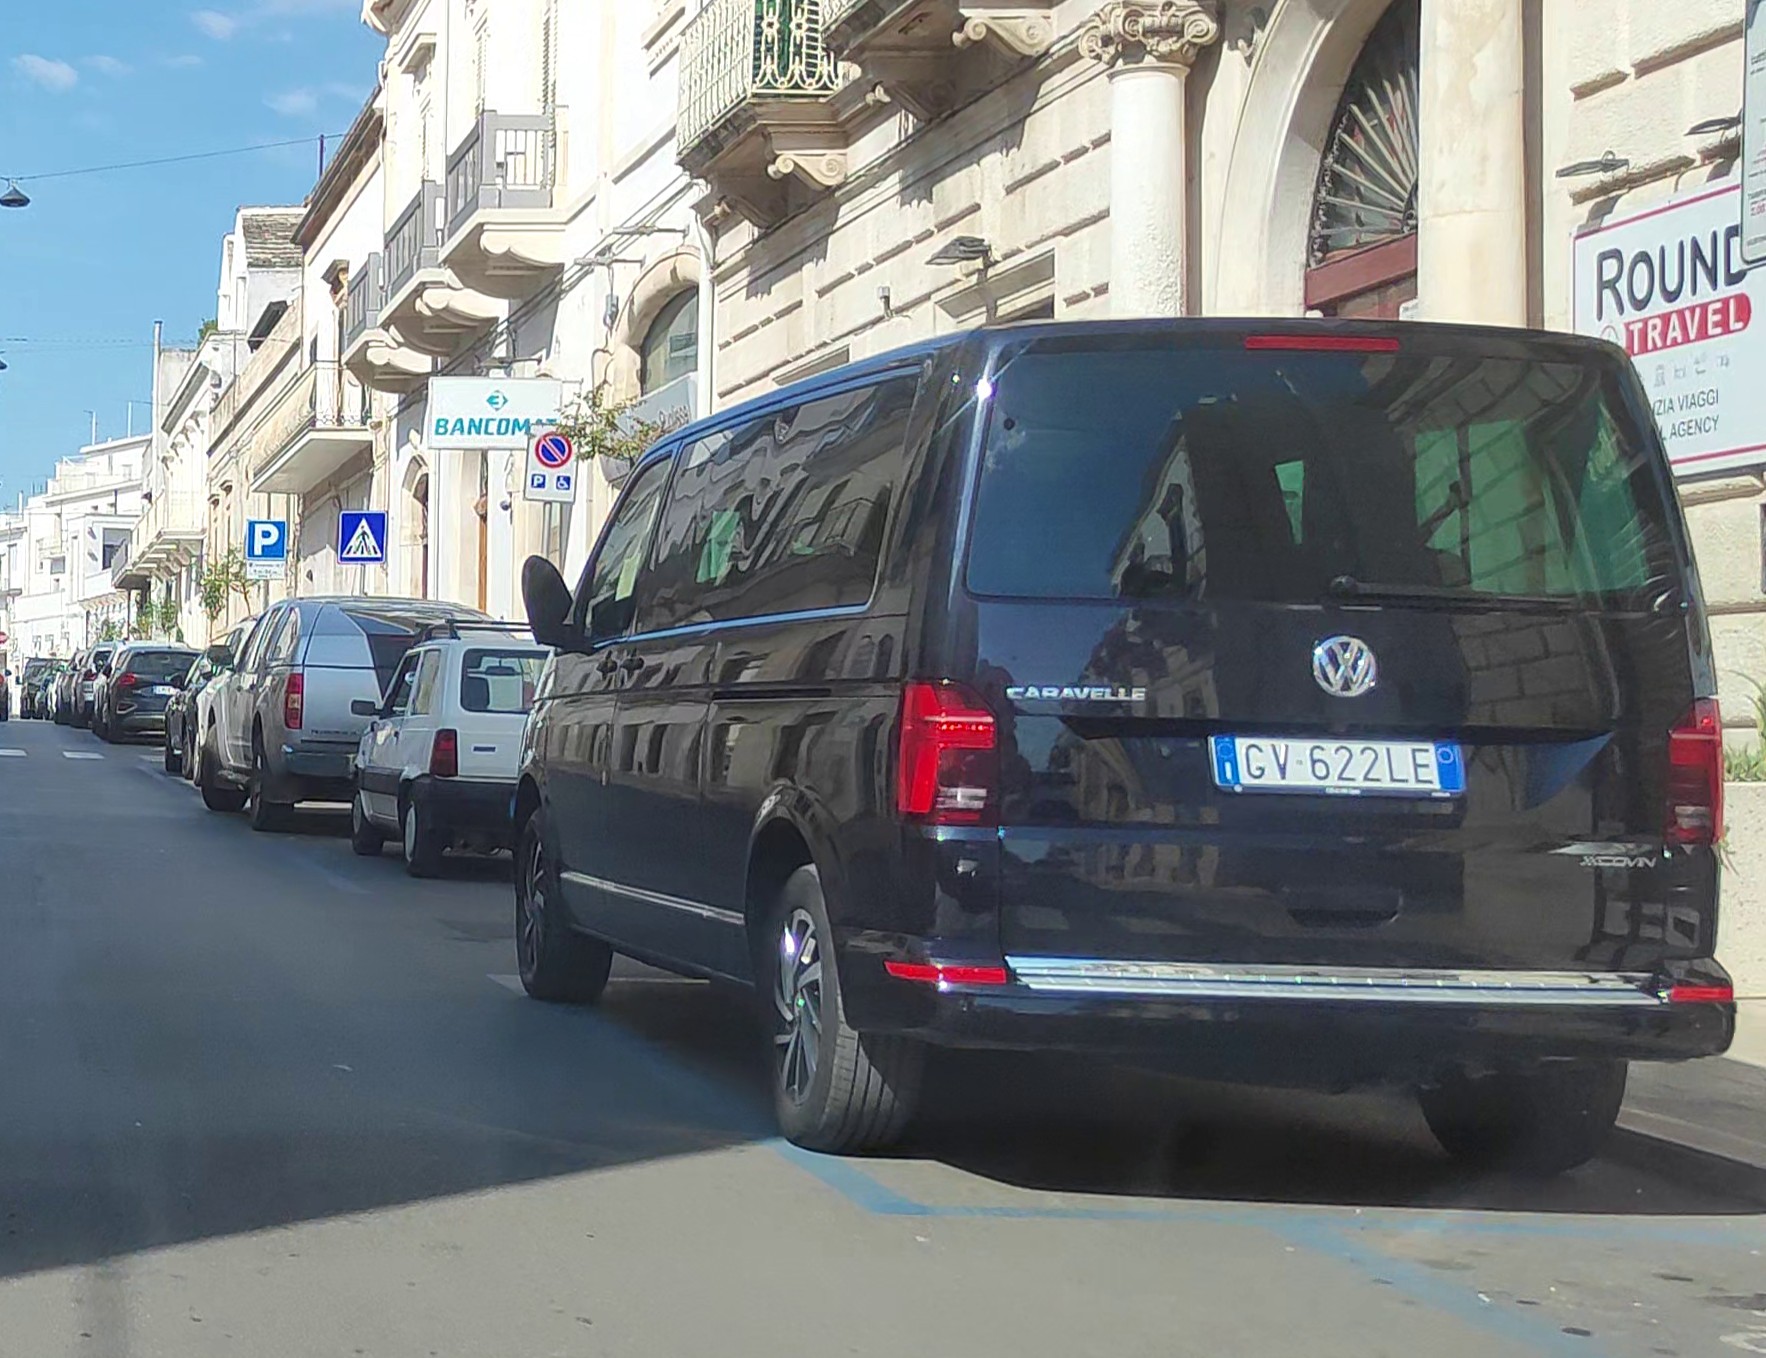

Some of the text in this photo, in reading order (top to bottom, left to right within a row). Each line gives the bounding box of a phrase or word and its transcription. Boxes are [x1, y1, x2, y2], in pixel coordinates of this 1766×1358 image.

[1596, 223, 1747, 322] ROUND
[1628, 298, 1744, 354] TRAVEL
[1677, 388, 1719, 412] VIAGGI
[1669, 414, 1720, 440] AGENCY
[533, 475, 544, 488] P
[253, 523, 280, 556] P
[1006, 686, 1146, 701] CARAVELLE
[1245, 743, 1290, 780] GV
[1309, 744, 1434, 784] 622LE
